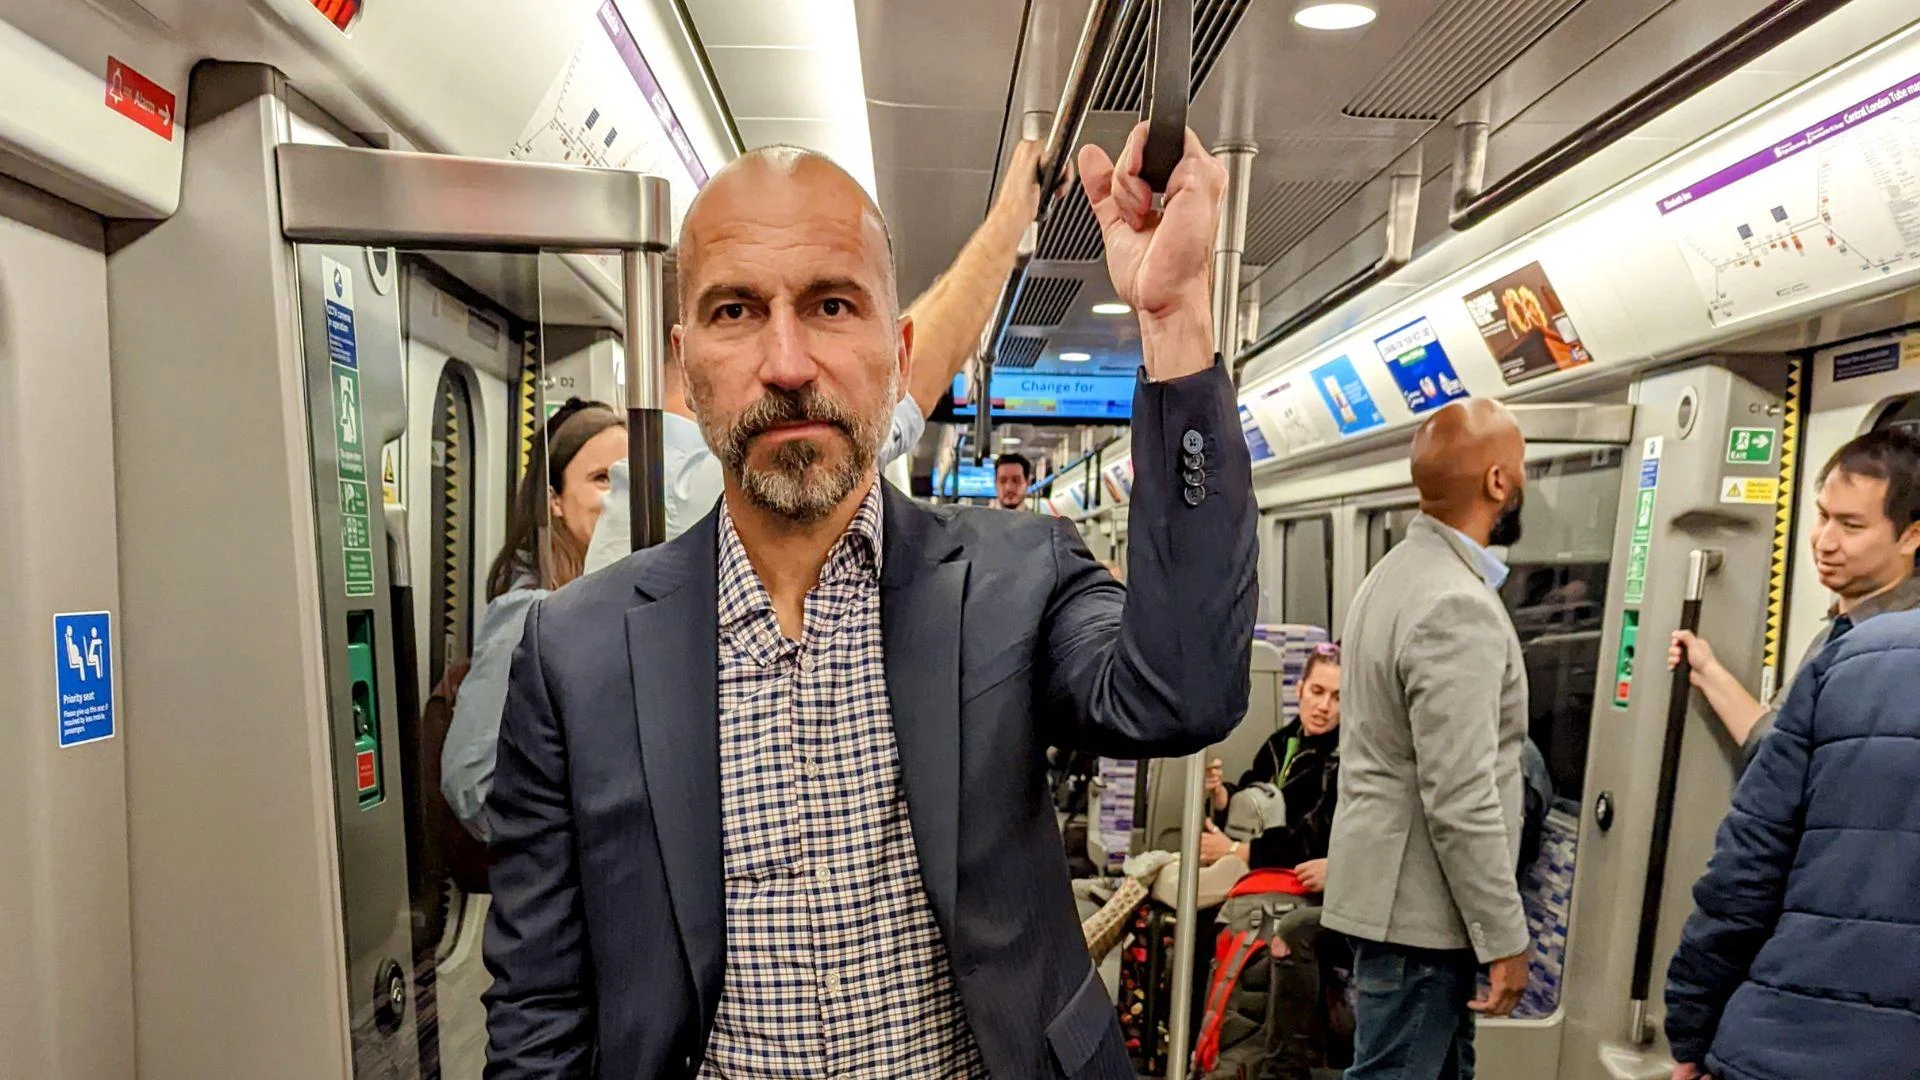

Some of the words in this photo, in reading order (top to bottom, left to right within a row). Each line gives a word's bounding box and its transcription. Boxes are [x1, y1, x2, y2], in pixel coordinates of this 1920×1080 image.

[134, 90, 155, 115] Alarm
[1843, 107, 1867, 123] Central
[1865, 98, 1890, 113] London
[1888, 88, 1908, 102] Tube
[1907, 82, 1920, 95] ma
[1021, 381, 1071, 394] Change
[1075, 382, 1095, 393] for
[1730, 450, 1747, 459] Exit
[63, 693, 82, 704] Priority
[83, 691, 95, 701] seat
